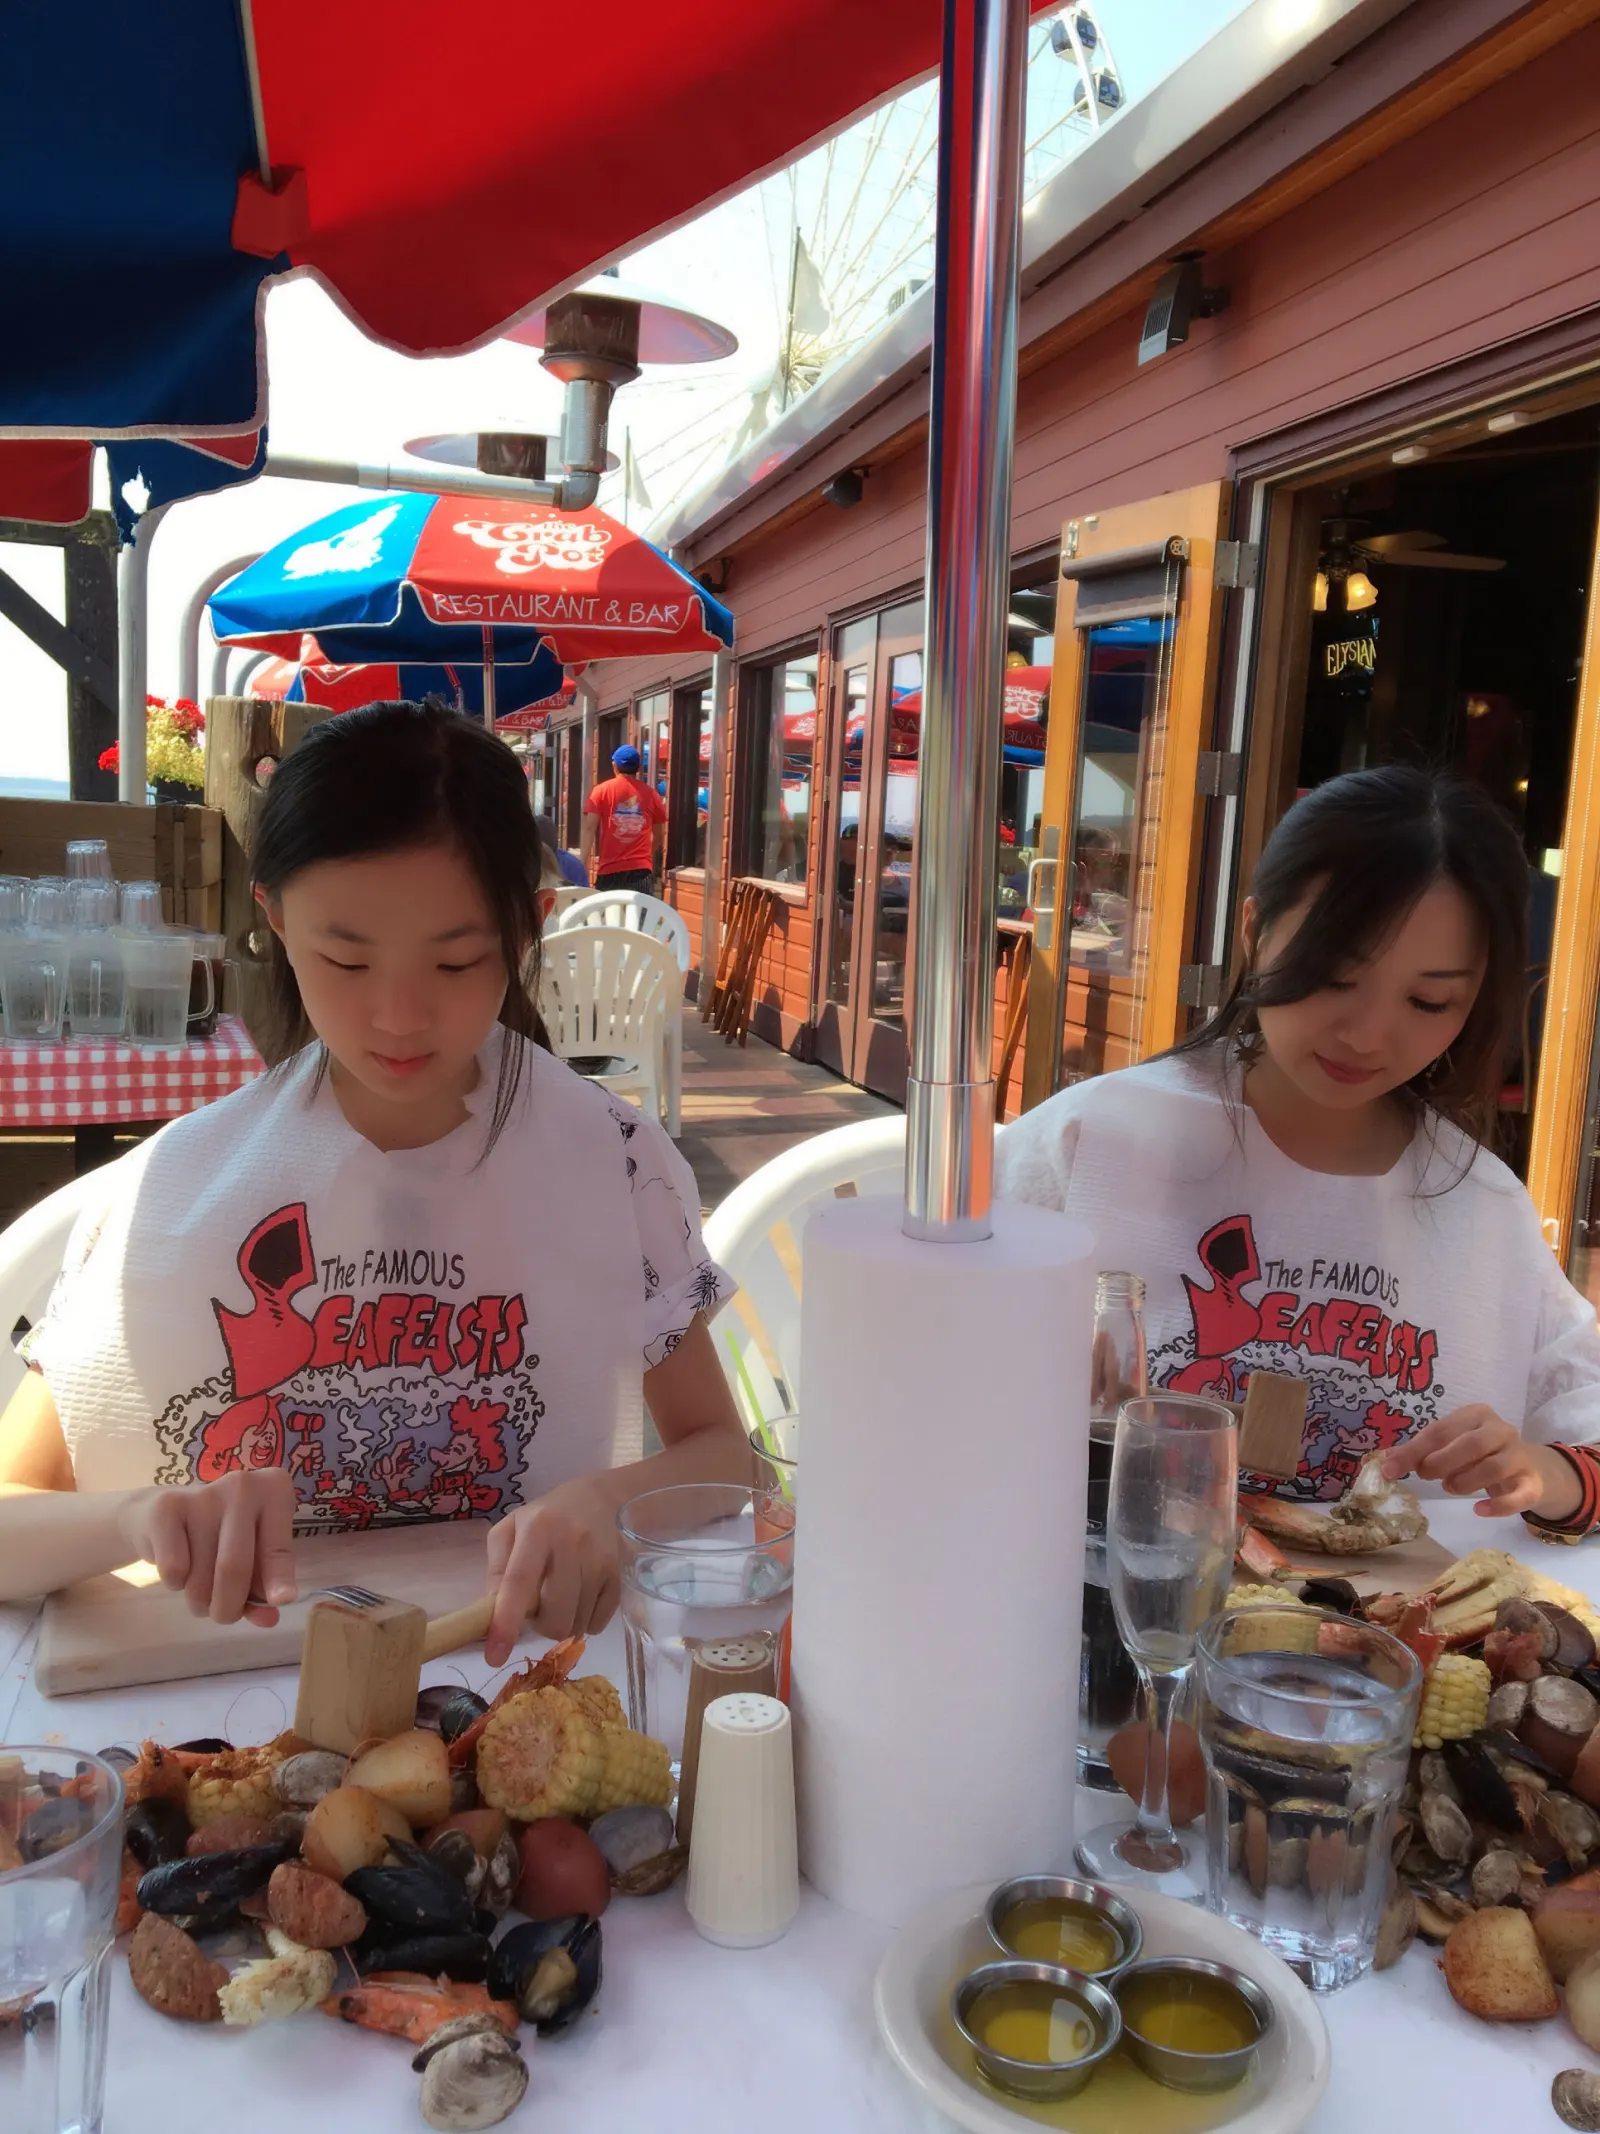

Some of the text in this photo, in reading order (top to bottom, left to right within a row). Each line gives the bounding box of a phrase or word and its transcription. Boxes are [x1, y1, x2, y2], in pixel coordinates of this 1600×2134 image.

[456, 520, 612, 547] Crab
[498, 543, 605, 571] Pot
[433, 593, 680, 625] RESTAURANT & BAR
[1327, 637, 1377, 676] ELYSIAN
[321, 1249, 465, 1292] The FAMOUS
[1265, 1259, 1400, 1308] The FAMOUS
